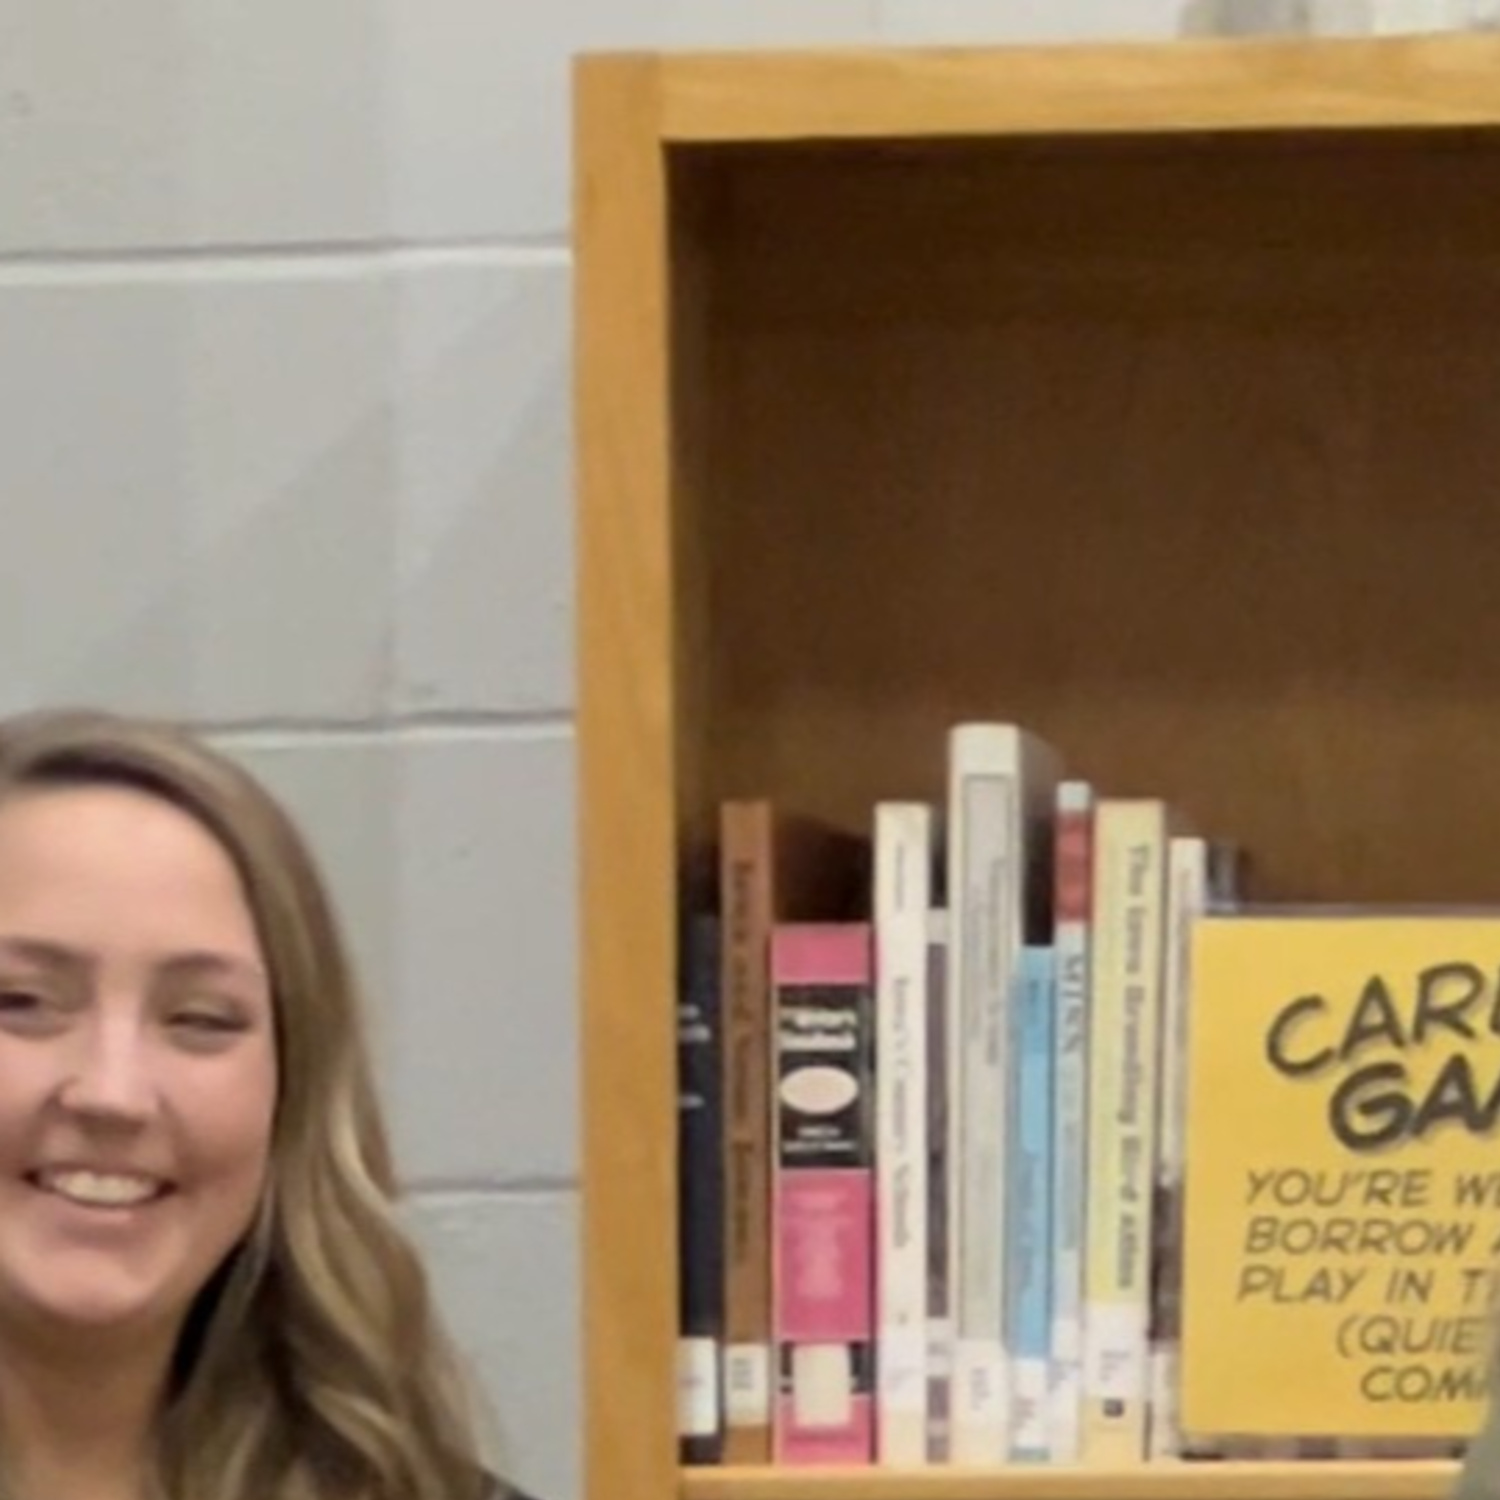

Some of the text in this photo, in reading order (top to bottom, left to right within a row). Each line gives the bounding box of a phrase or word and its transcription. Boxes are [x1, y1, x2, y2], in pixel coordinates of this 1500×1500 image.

[1244, 1168, 1433, 1208] YOU'RE
[1244, 1216, 1476, 1257] BORROW
[1237, 1265, 1366, 1304] PLAY
[1386, 1267, 1436, 1303] IN
